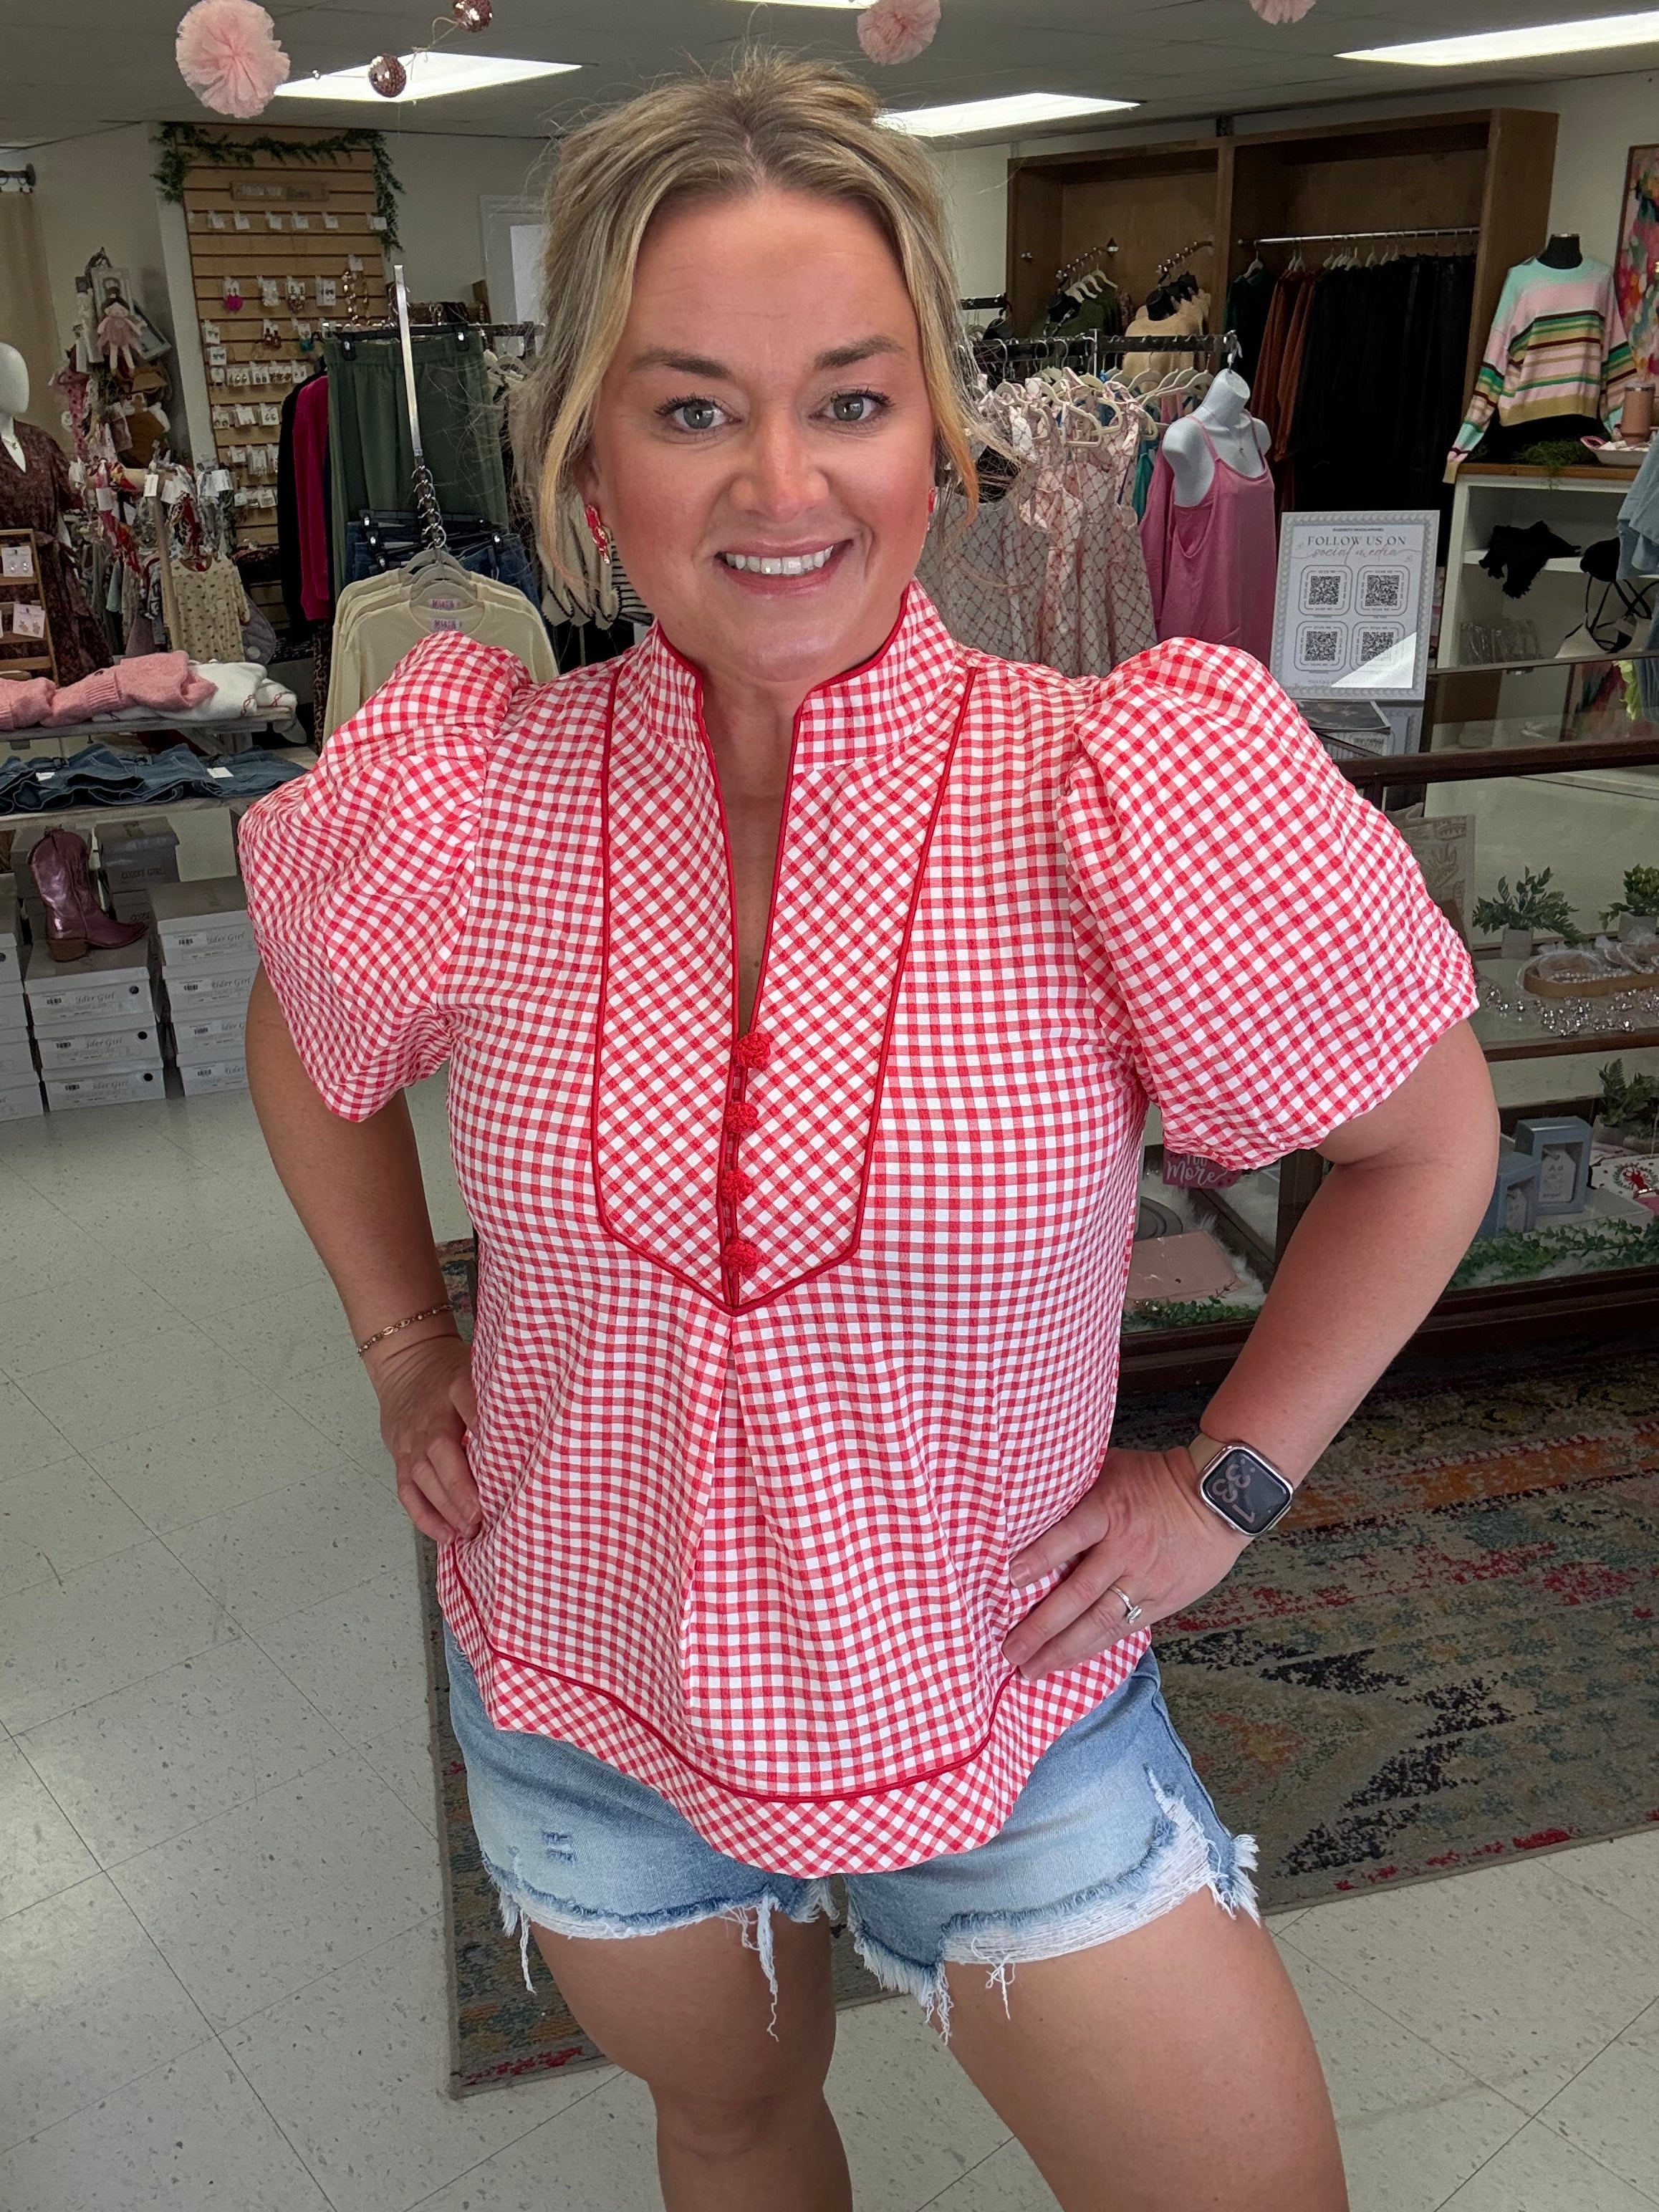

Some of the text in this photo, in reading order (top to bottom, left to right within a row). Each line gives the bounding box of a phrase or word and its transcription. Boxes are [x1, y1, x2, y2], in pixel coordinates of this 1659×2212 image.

[1308, 536, 1406, 546] FOLLOW US ON
